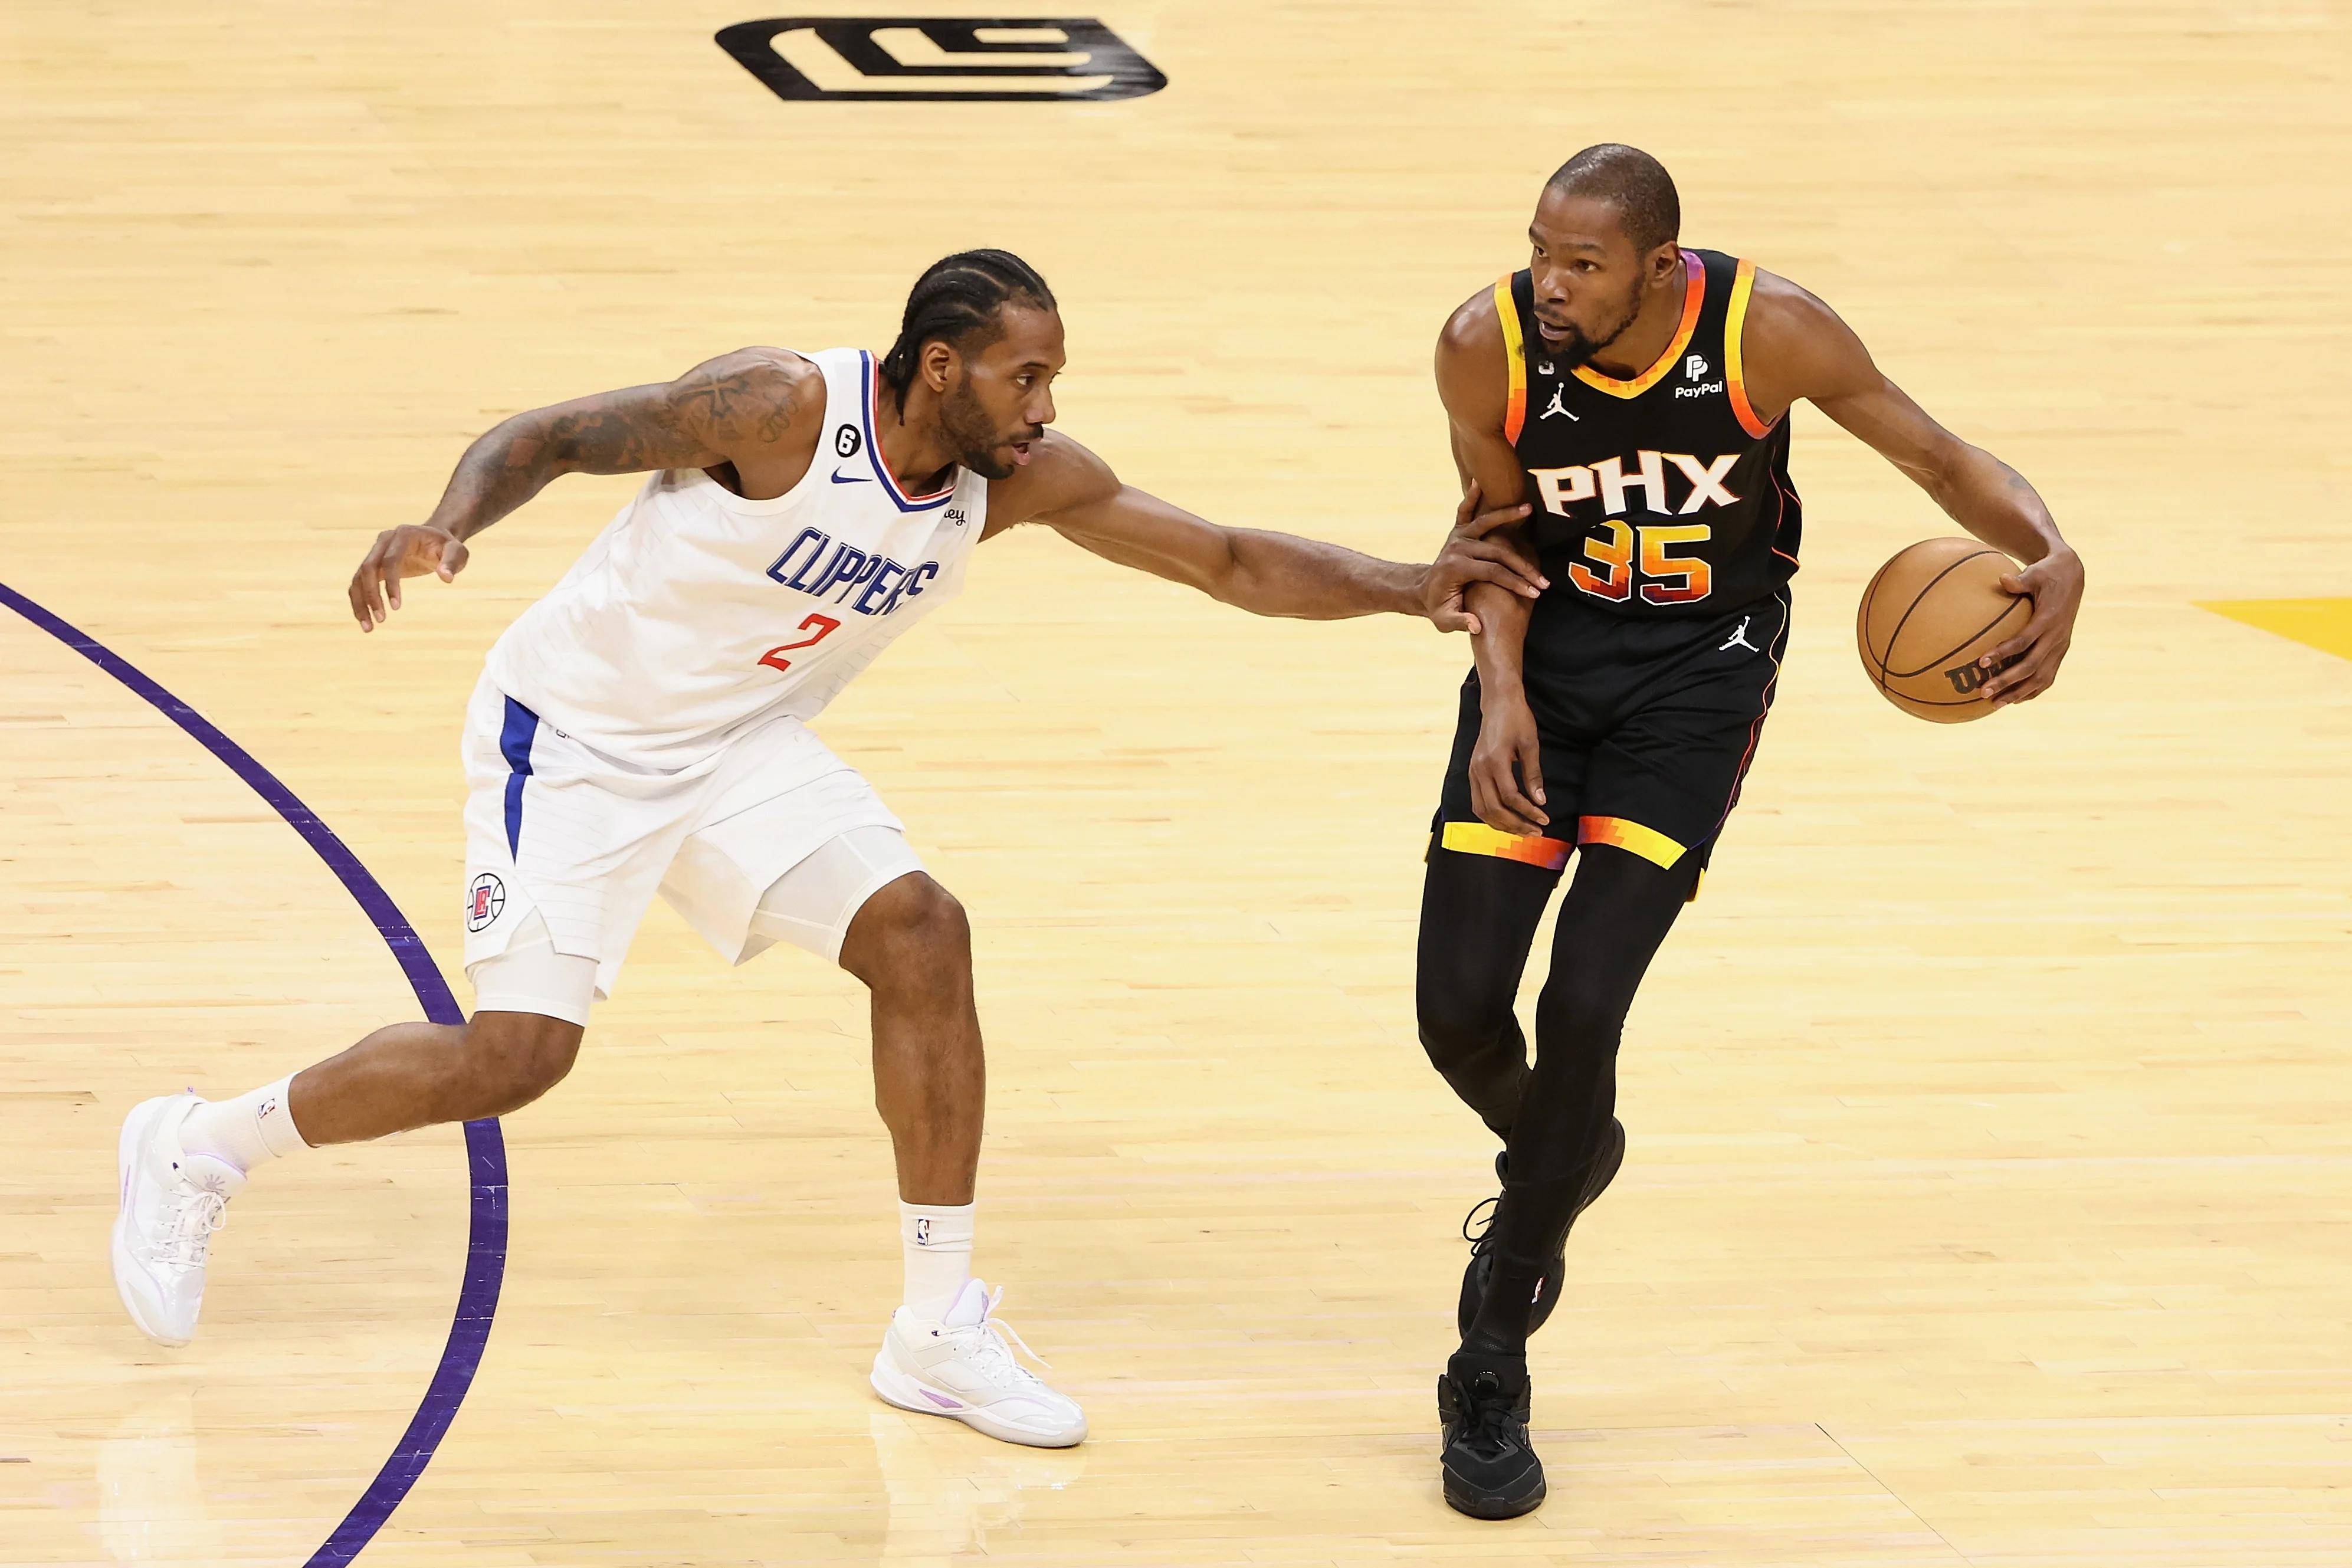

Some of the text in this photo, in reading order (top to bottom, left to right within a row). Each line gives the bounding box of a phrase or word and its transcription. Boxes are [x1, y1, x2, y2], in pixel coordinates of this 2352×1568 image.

[1675, 380, 1723, 399] PayPal
[838, 428, 855, 455] 6
[1527, 450, 1744, 517] PHX
[1568, 520, 1711, 606] 35
[757, 612, 841, 672] 2
